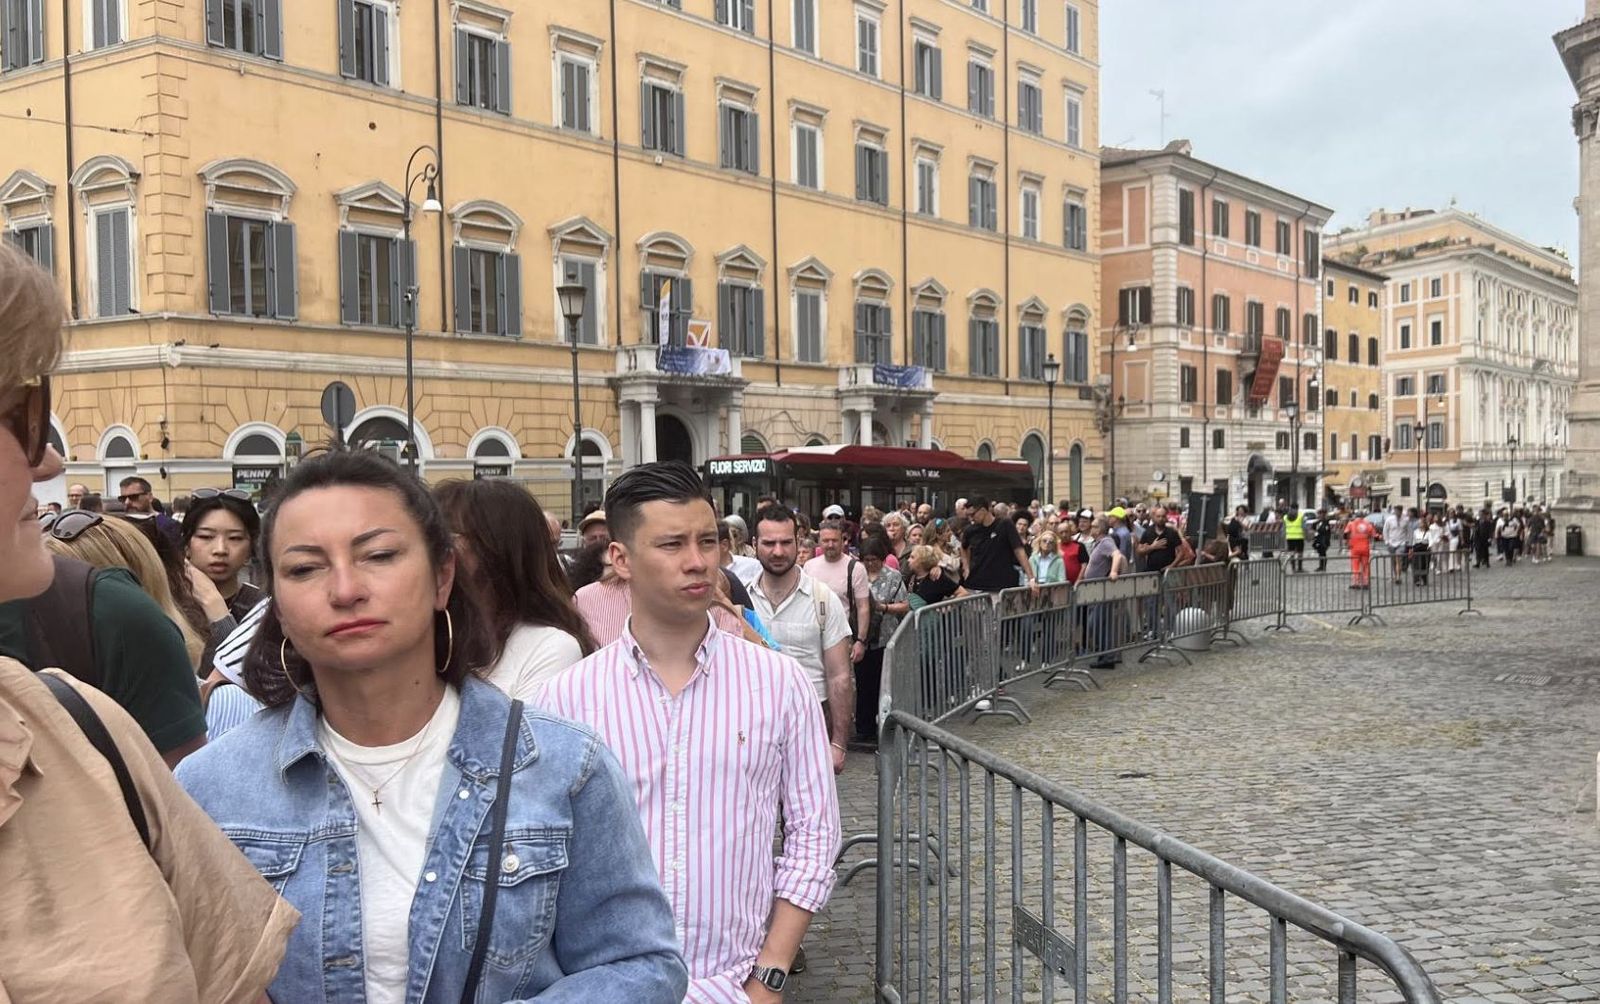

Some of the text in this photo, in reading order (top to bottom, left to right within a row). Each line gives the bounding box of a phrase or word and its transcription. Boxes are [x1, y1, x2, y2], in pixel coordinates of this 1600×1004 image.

[710, 459, 766, 474] FUORI SERVIZIO
[236, 469, 271, 478] PENNY
